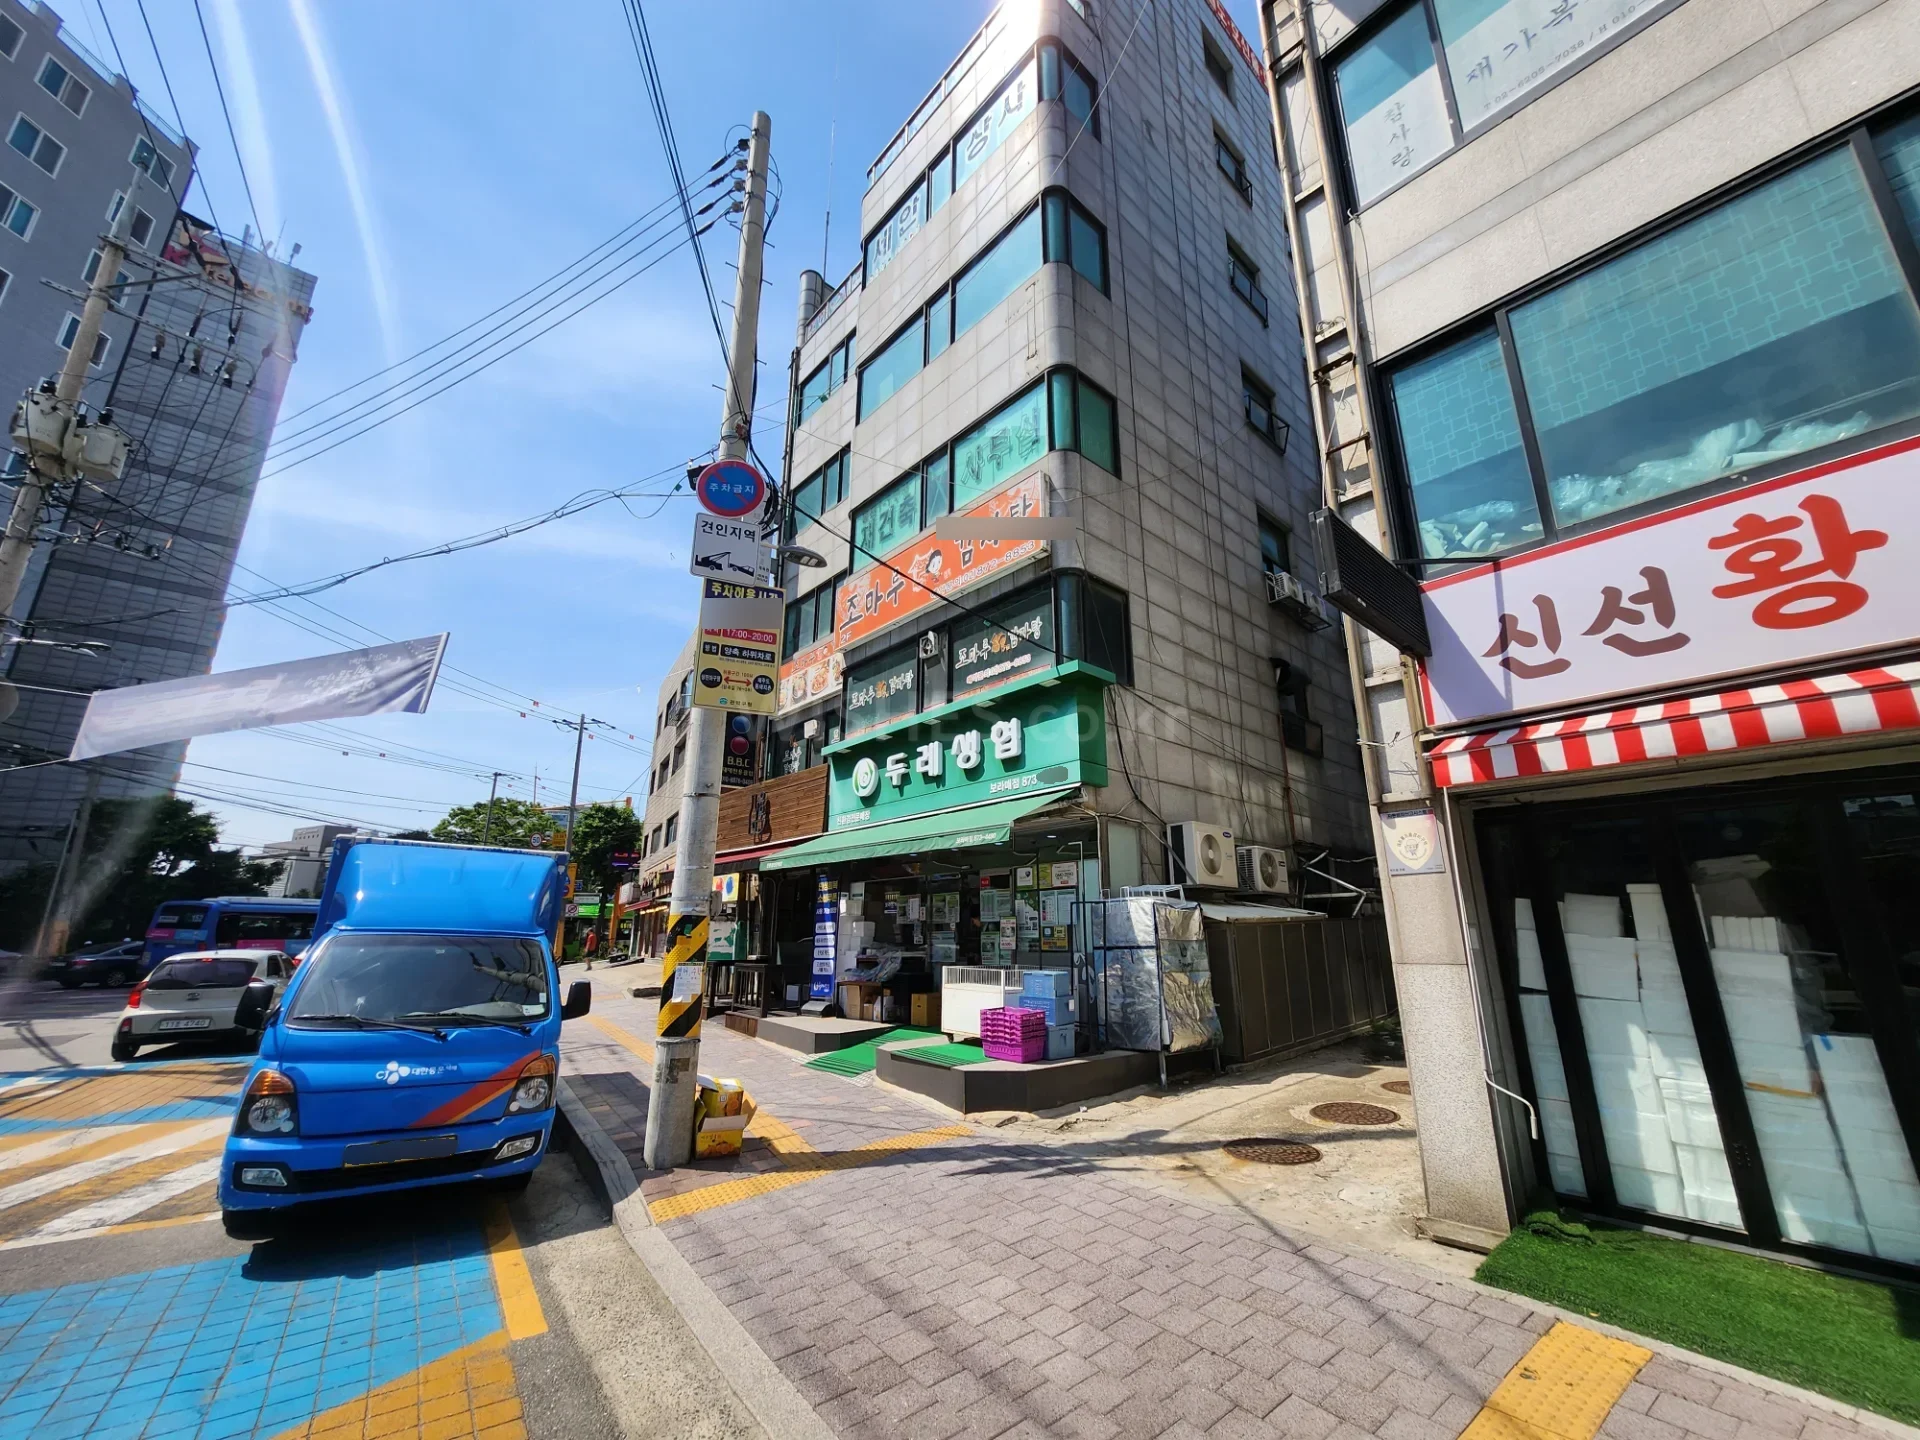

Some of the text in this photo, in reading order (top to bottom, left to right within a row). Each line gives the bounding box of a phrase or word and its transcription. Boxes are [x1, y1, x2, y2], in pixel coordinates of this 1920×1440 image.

[1465, 0, 1592, 85] 재가복
[960, 407, 1041, 487] 사무실
[708, 481, 755, 495] 주차금지
[701, 519, 757, 543] 견인지역
[839, 566, 905, 632] 조마루
[841, 631, 853, 645] 2F
[724, 646, 772, 661] 양측 하위차로
[955, 637, 993, 670] 조마루
[884, 716, 1023, 787] 두레생협
[727, 756, 751, 768] B.B.C
[989, 778, 1021, 794] 보라매점
[532, 836, 541, 844] 50
[375, 1070, 390, 1081] CJ
